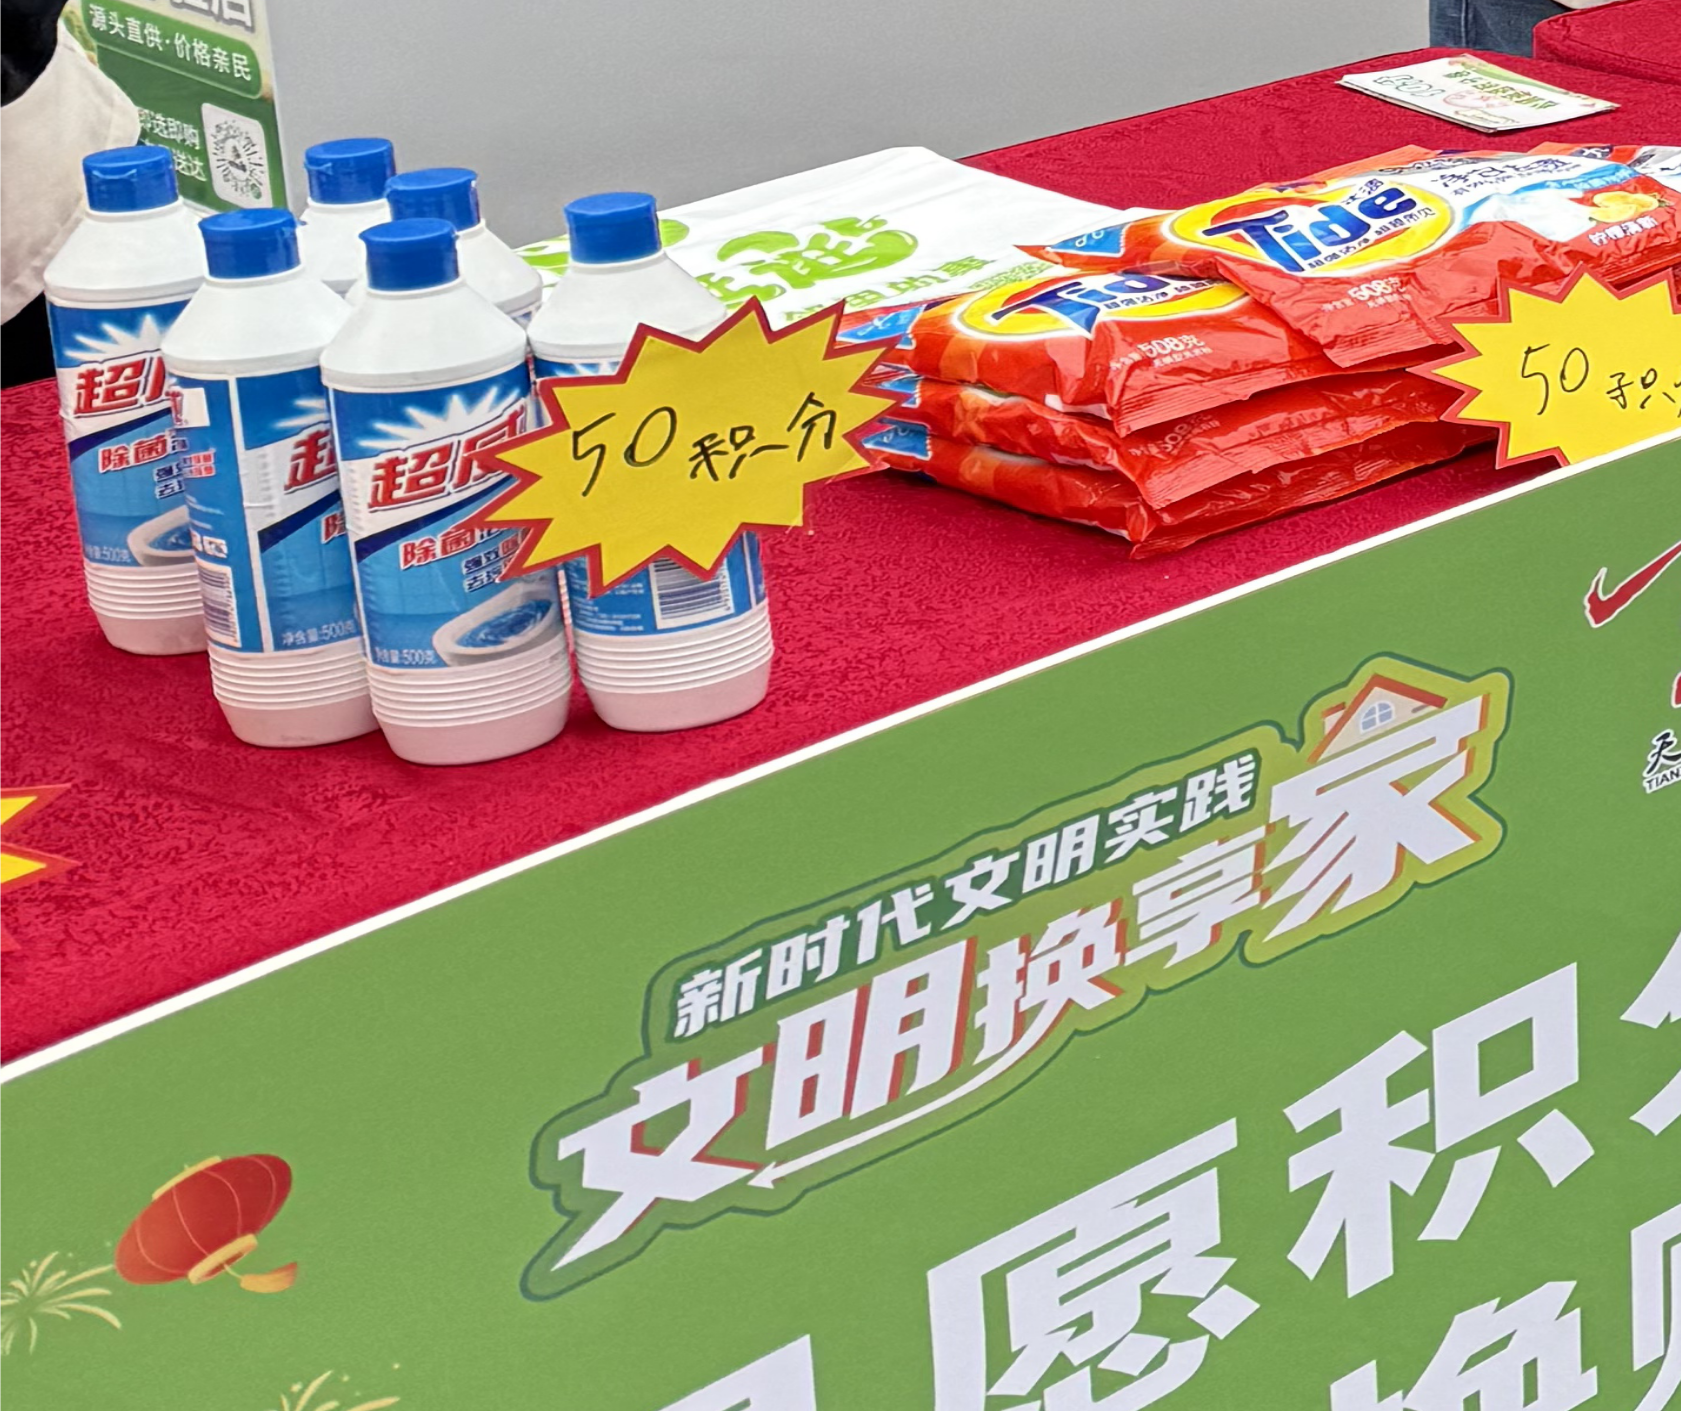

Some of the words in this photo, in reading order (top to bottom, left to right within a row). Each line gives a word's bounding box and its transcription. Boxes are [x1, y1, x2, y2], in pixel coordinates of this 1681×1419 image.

[89, 3, 252, 82] 源头直供·价格亲民
[1201, 186, 1408, 273] Tide
[73, 354, 167, 417] 超
[675, 754, 1256, 1037] 新时代文明实践
[551, 693, 1486, 1271] 文明换享家
